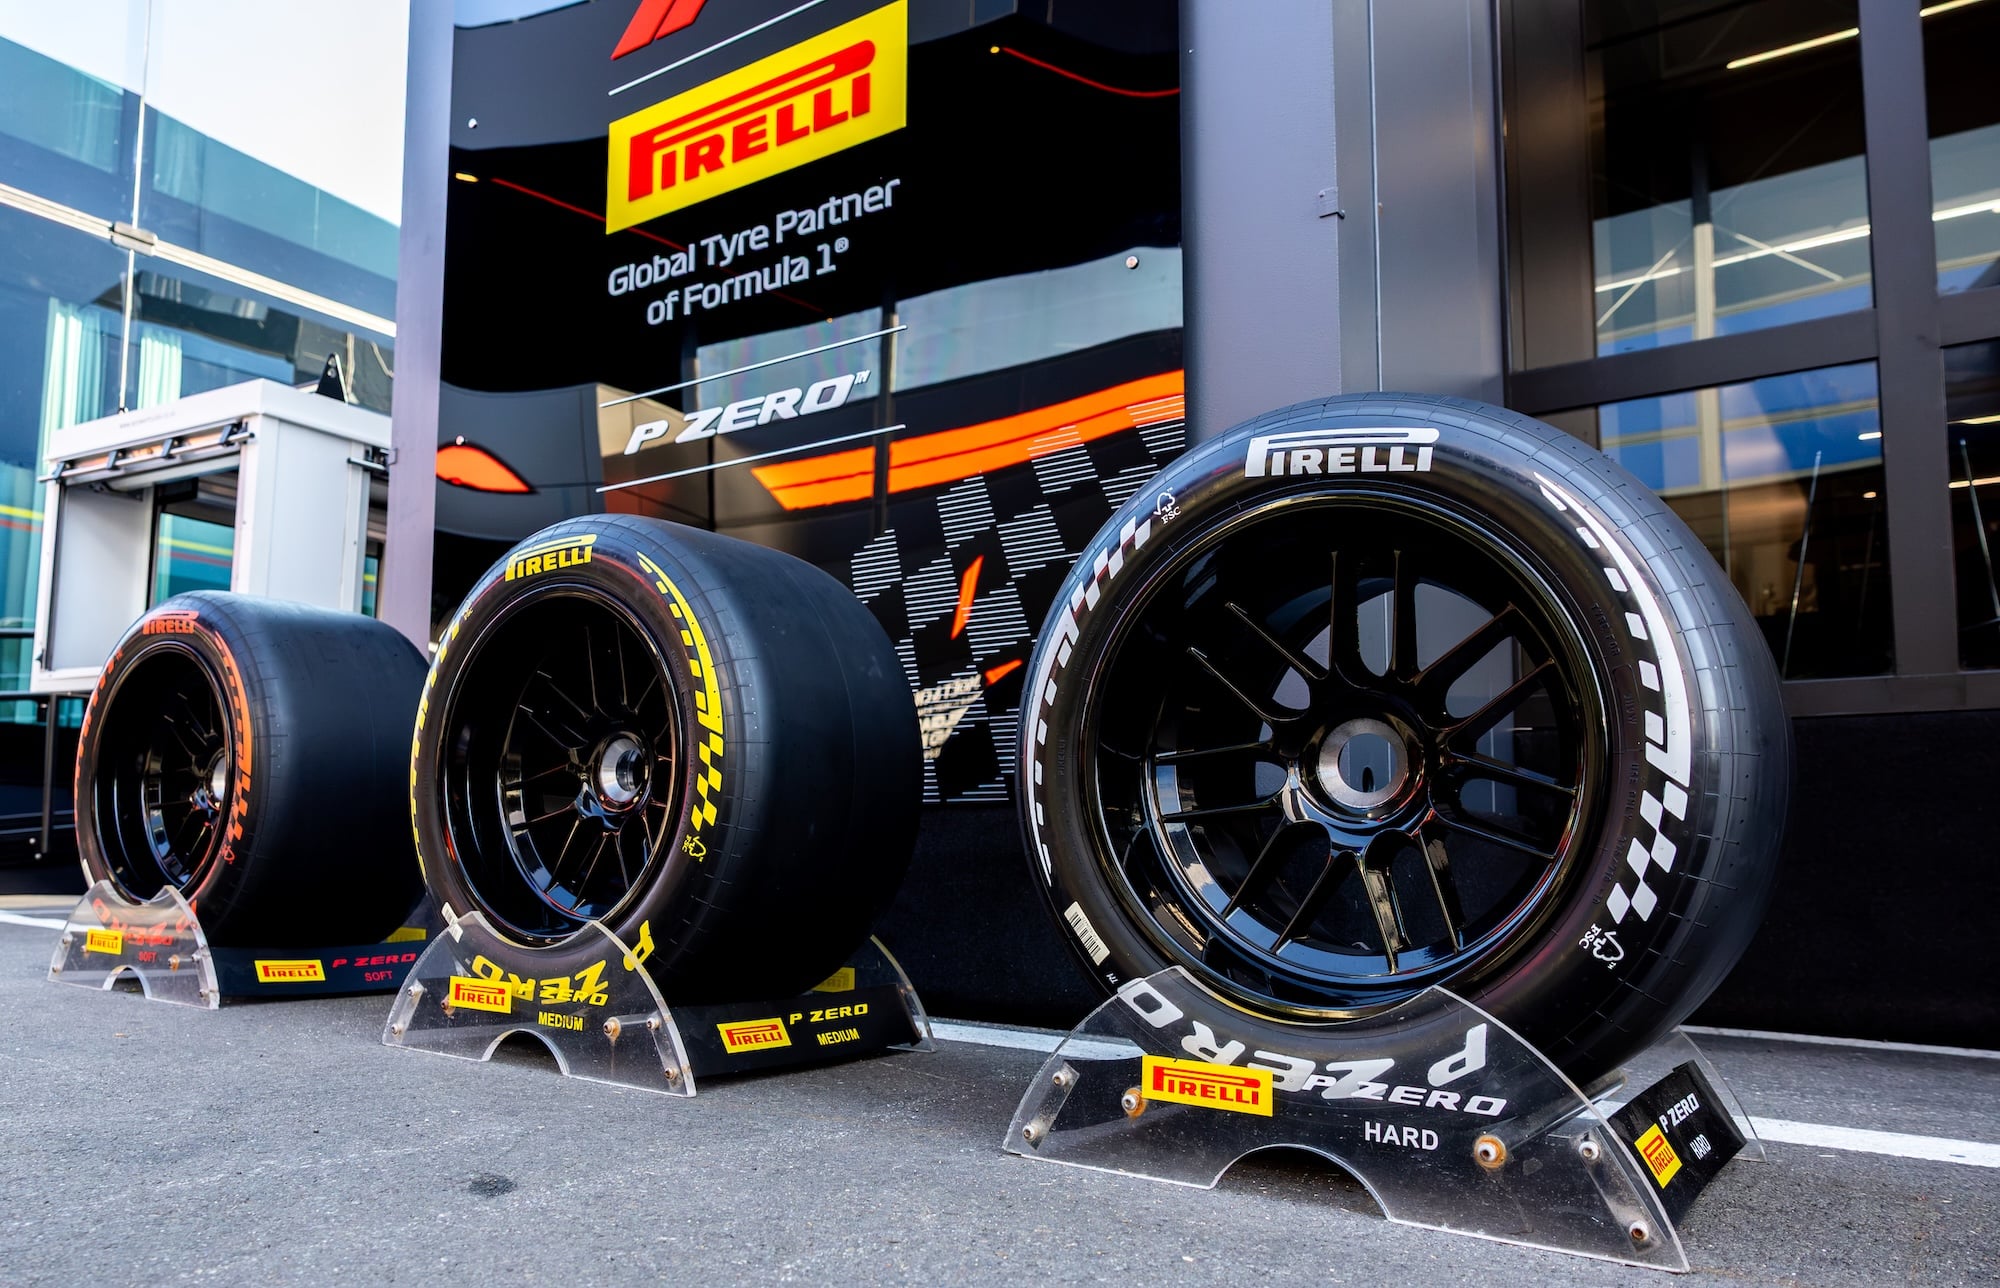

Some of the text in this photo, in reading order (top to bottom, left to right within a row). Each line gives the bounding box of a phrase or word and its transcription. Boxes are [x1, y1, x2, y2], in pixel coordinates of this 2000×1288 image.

[628, 39, 876, 202] PIRELLI
[608, 178, 900, 296] Global Tyre Partner
[647, 290, 680, 325] of
[683, 255, 809, 315] Formula
[624, 419, 669, 456] P
[1244, 427, 1440, 478] PIRELLI
[1161, 506, 1182, 525] FSC
[505, 534, 597, 582] PIRELLI
[142, 610, 199, 635] PIRELLI
[90, 933, 118, 949] PIRELLI
[1579, 923, 1602, 949] FSC
[138, 951, 157, 963] SOFT
[331, 953, 416, 969] P ZERO
[263, 964, 318, 978] PIRELLI
[364, 971, 393, 982] SOFT
[455, 984, 505, 1007] PIRELLI
[539, 986, 609, 1007] ZERO
[538, 1011, 584, 1032] MEDIUM
[789, 1003, 868, 1025] P ZERO
[726, 1024, 783, 1046] PIRELLI
[816, 1028, 860, 1046] MEDIUM
[1428, 1022, 1488, 1088] P
[1153, 1065, 1261, 1106] PIRELLI
[1301, 1074, 1507, 1117] P ZERO
[1659, 1094, 1700, 1134] P ZERO
[1364, 1121, 1439, 1150] HARD
[1689, 1133, 1711, 1160] HARD
[1643, 1134, 1674, 1175] PIRELLI
